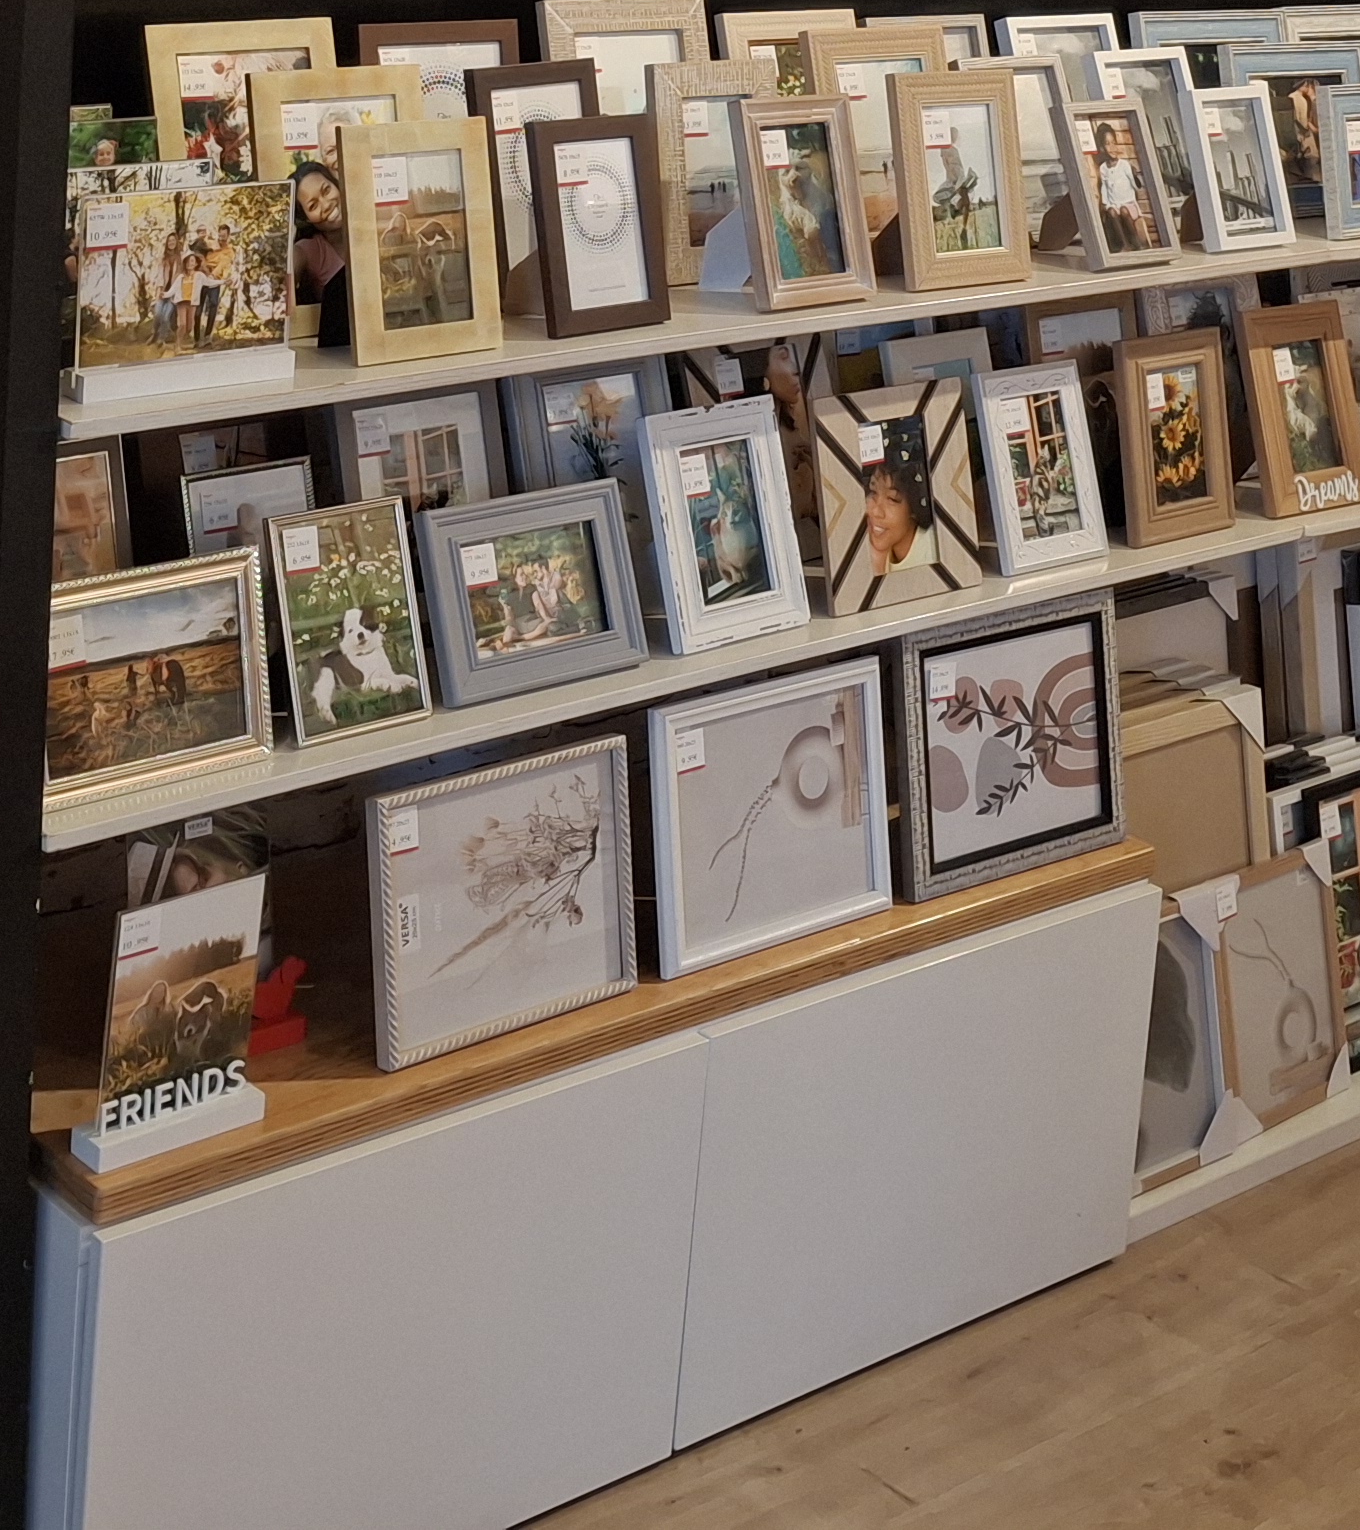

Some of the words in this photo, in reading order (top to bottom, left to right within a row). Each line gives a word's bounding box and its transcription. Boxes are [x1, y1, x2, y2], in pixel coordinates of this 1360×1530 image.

[1293, 470, 1360, 513] Dreams
[187, 821, 208, 832] VERSA
[401, 906, 410, 947] VERSA
[99, 1057, 248, 1132] FRIENDS
